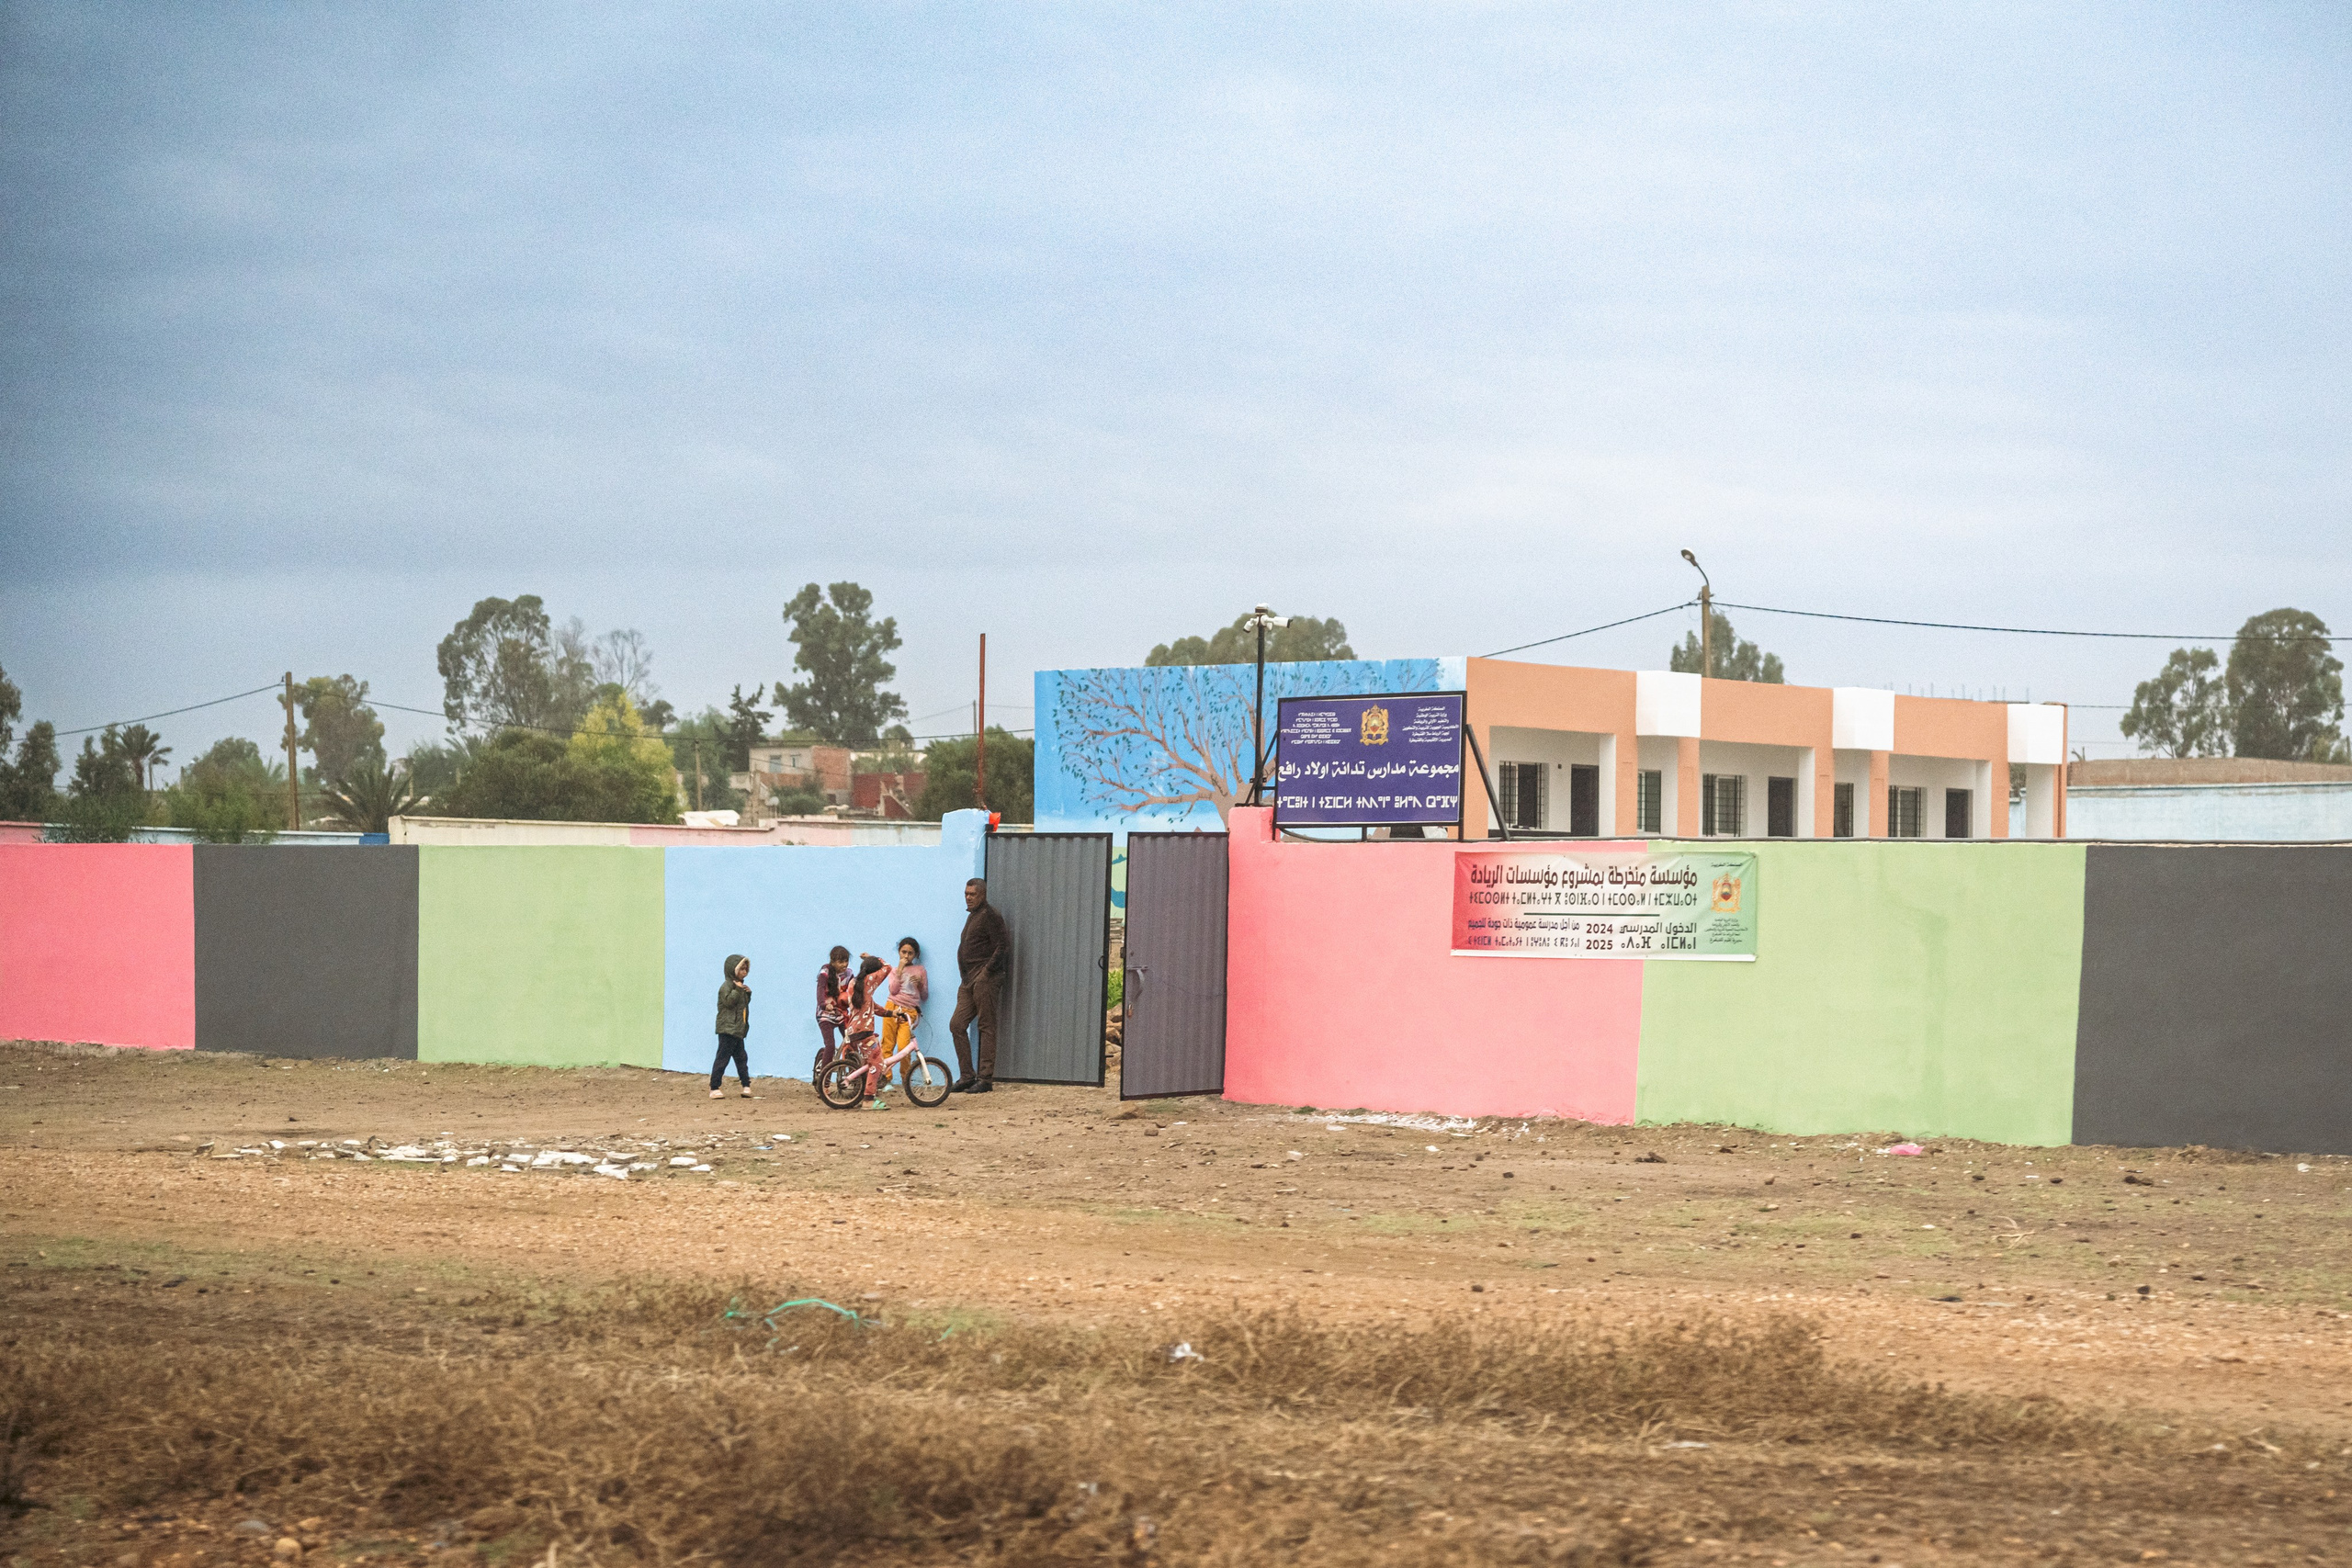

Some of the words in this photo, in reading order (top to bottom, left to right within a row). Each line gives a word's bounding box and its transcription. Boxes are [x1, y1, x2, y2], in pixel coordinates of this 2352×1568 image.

[1277, 761, 1302, 782] رافع
[1305, 761, 1329, 779] اولاد
[1331, 761, 1365, 778] تدانة
[1366, 761, 1407, 780] مدارس
[1408, 760, 1459, 779] مجموعة
[1471, 864, 1503, 888] الريادة
[1507, 864, 1558, 889] مؤسسات
[1562, 863, 1604, 889] بمشروع
[1608, 865, 1646, 889] منخرطة
[1650, 864, 1698, 889] مؤسسة
[1586, 923, 1613, 934] 2024
[1619, 922, 1663, 935] المدرسي
[1665, 922, 1697, 935] الدخول
[1586, 940, 1613, 950] 2025
